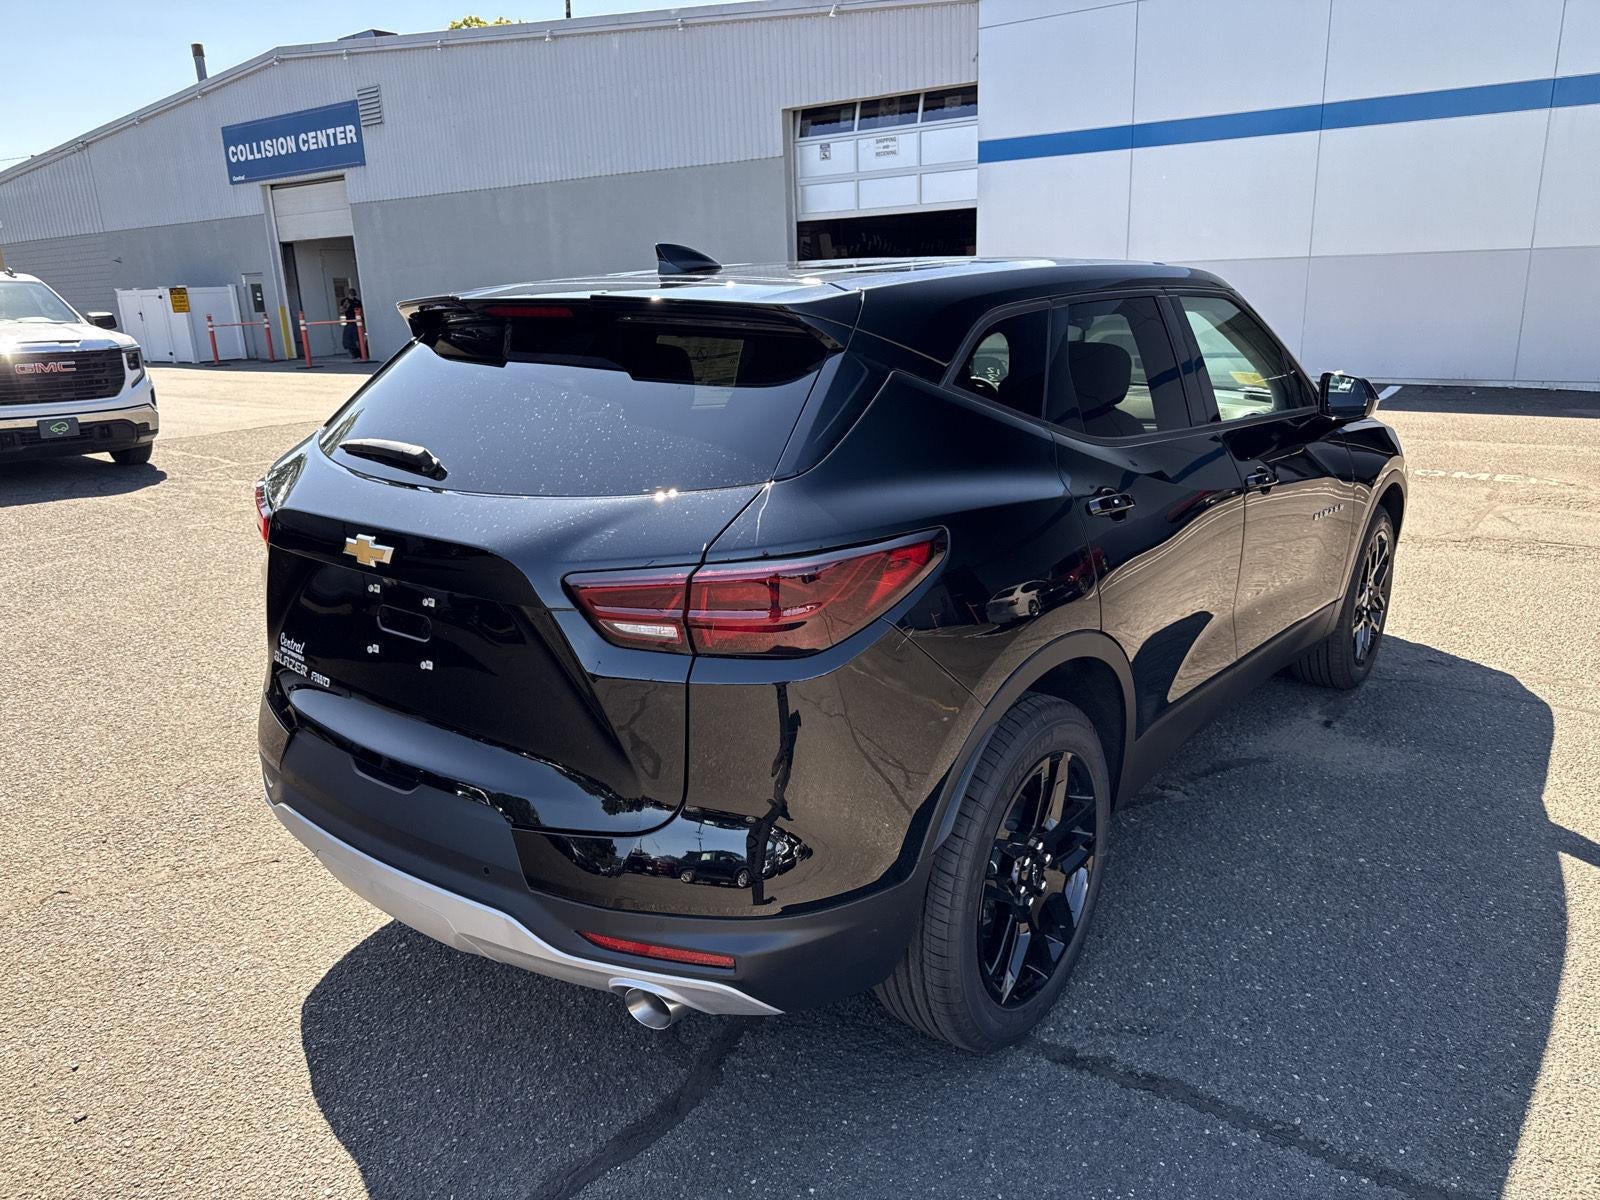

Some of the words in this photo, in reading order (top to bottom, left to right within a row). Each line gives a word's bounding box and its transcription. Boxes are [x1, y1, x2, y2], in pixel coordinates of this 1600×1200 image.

[228, 135, 297, 163] COLLISION
[298, 124, 358, 152] CENTER
[14, 360, 77, 375] GMC
[280, 631, 305, 654] Central
[273, 650, 308, 678] BLAZER
[310, 671, 331, 688] AWD
